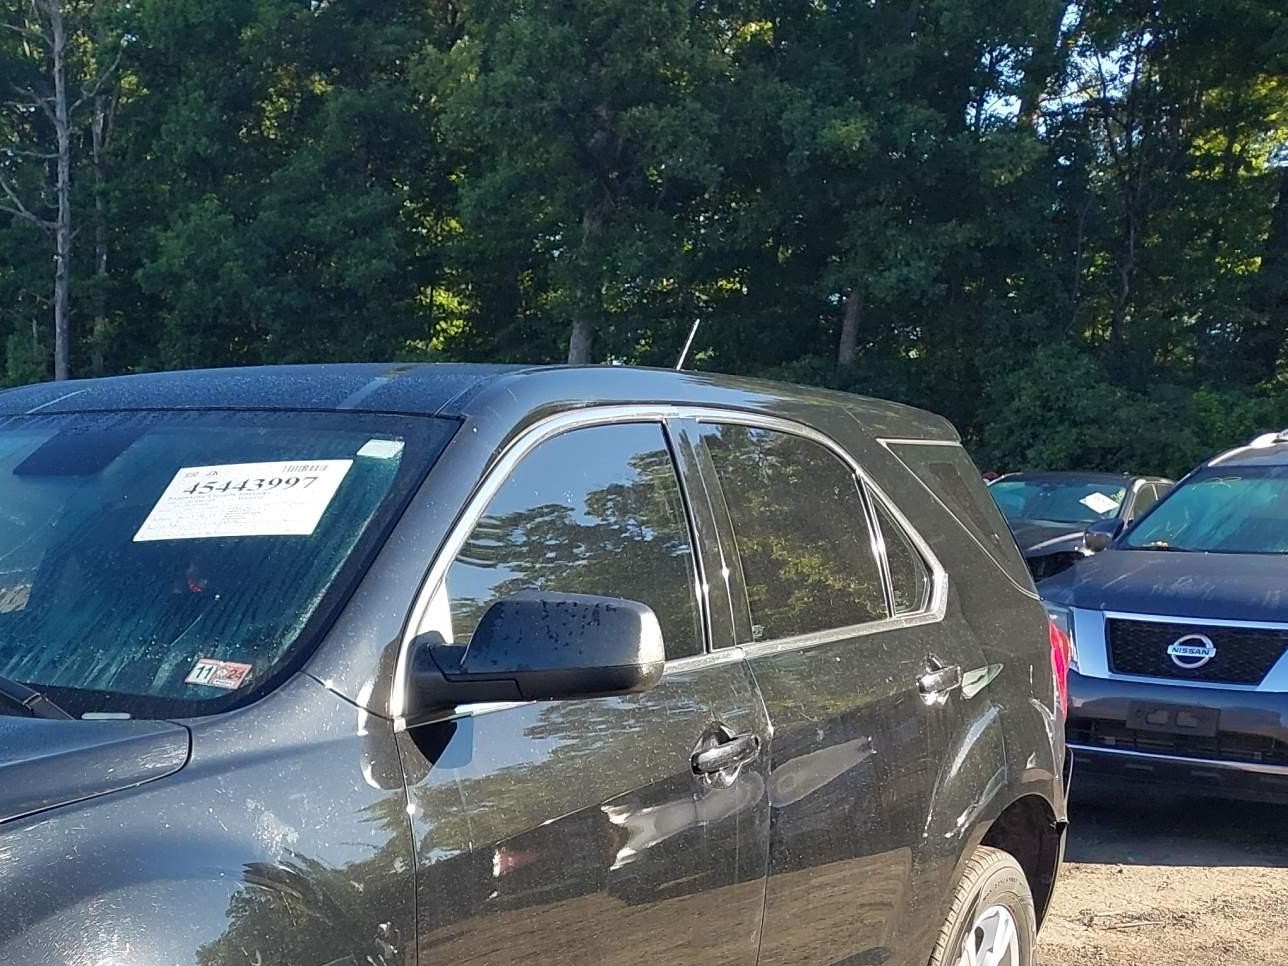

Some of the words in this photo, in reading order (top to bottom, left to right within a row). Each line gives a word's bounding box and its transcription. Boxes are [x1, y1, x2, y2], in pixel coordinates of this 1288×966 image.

[183, 476, 320, 495] 45443997
[1171, 647, 1210, 656] NISSAN
[195, 665, 214, 679] 11
